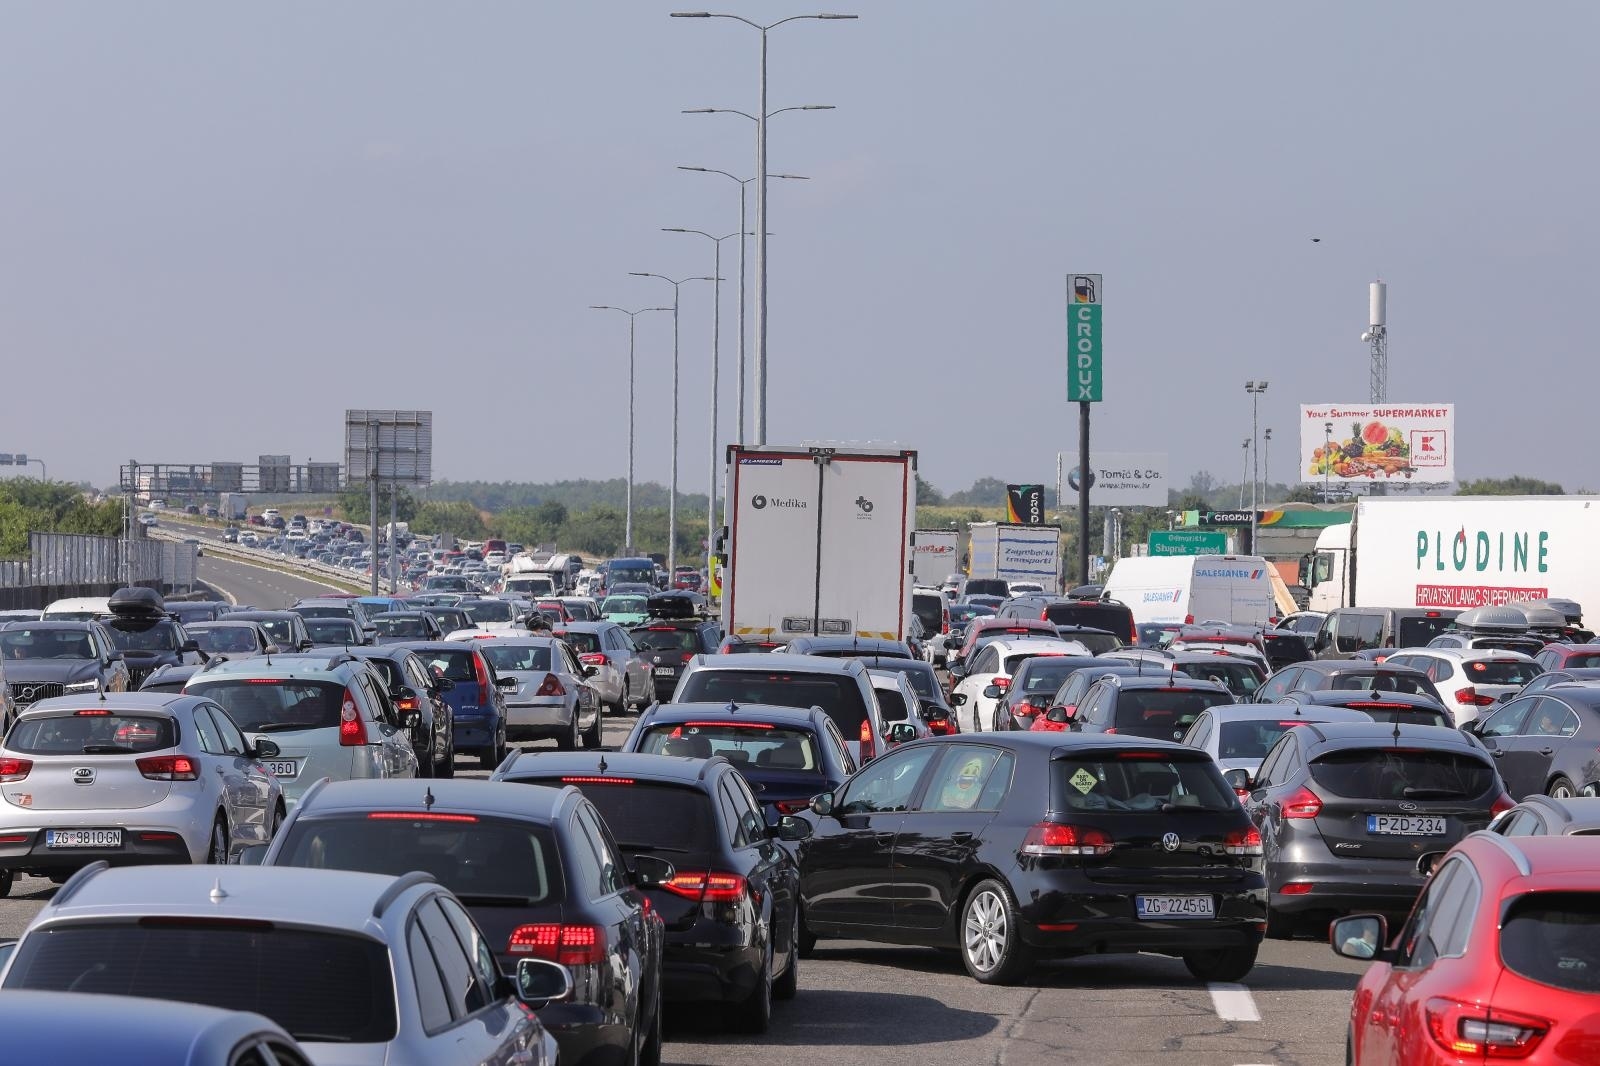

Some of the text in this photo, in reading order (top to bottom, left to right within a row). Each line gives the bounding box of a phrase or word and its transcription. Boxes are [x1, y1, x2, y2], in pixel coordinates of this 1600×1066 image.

[1077, 307, 1093, 399] CRODUX
[1306, 408, 1448, 418] Your Summer SUPERMARKET
[1134, 470, 1142, 478] &
[1144, 469, 1162, 479] Co.
[770, 498, 807, 509] Medika
[1416, 529, 1549, 573] PLODINE
[1195, 569, 1249, 578] SALESIANER
[1143, 592, 1173, 603] SALESIANER
[1417, 587, 1454, 604] HRVATSKI
[1455, 588, 1480, 606] LANAC
[1379, 817, 1443, 832] PZD-234
[55, 832, 69, 844] ZG
[1145, 898, 1161, 912] ZG
